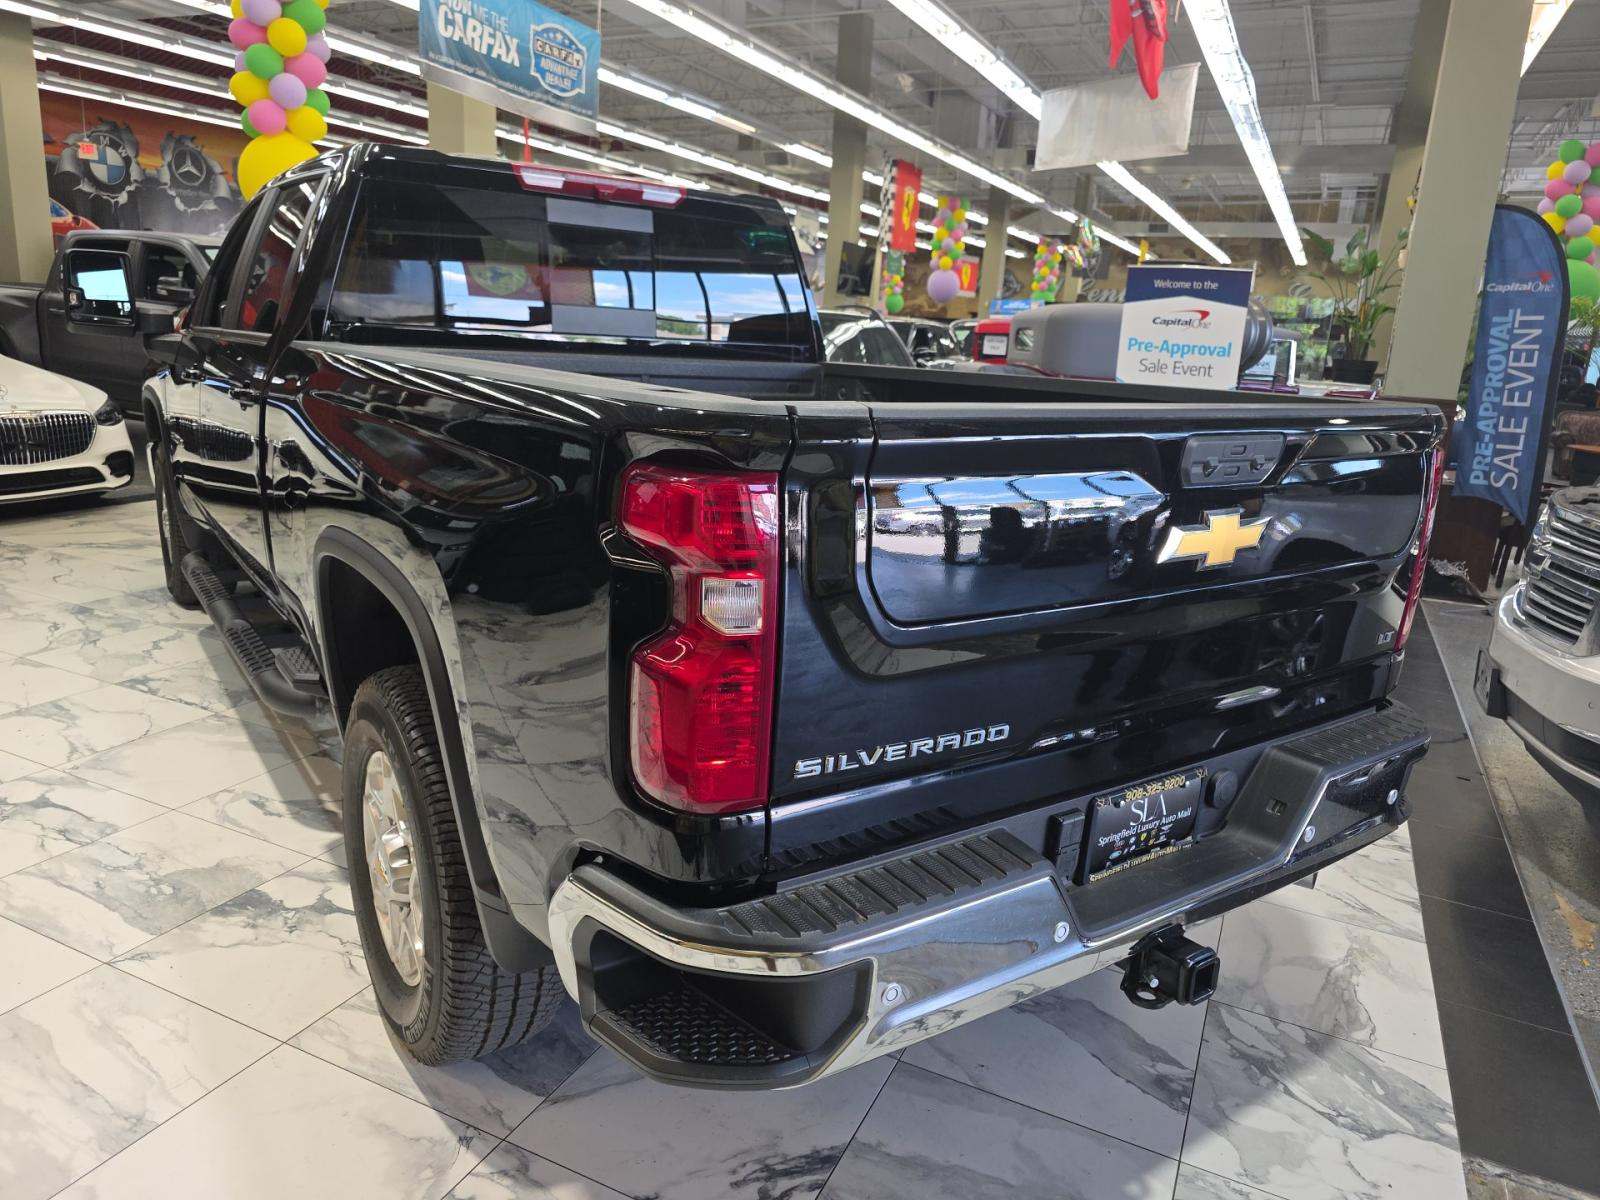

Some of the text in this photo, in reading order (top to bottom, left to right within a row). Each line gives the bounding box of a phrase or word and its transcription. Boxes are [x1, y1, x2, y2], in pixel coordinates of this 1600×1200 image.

[438, 4, 520, 67] CARFAX
[490, 11, 509, 34] THE
[536, 39, 583, 67] CARFAX
[1153, 279, 1219, 290] Welcome to the
[1127, 337, 1232, 359] Pre-Approval
[1138, 358, 1214, 378] Sale Event
[1469, 308, 1515, 485] PRE-APPROVAL
[1490, 308, 1544, 490] SALE EVENT
[793, 723, 1010, 779] SILVERADO
[1129, 794, 1167, 826] SLA
[1098, 825, 1137, 848] Springfield
[1137, 819, 1161, 832] Luxury
[1159, 814, 1177, 826] Auto
[1176, 807, 1192, 819] Mall
